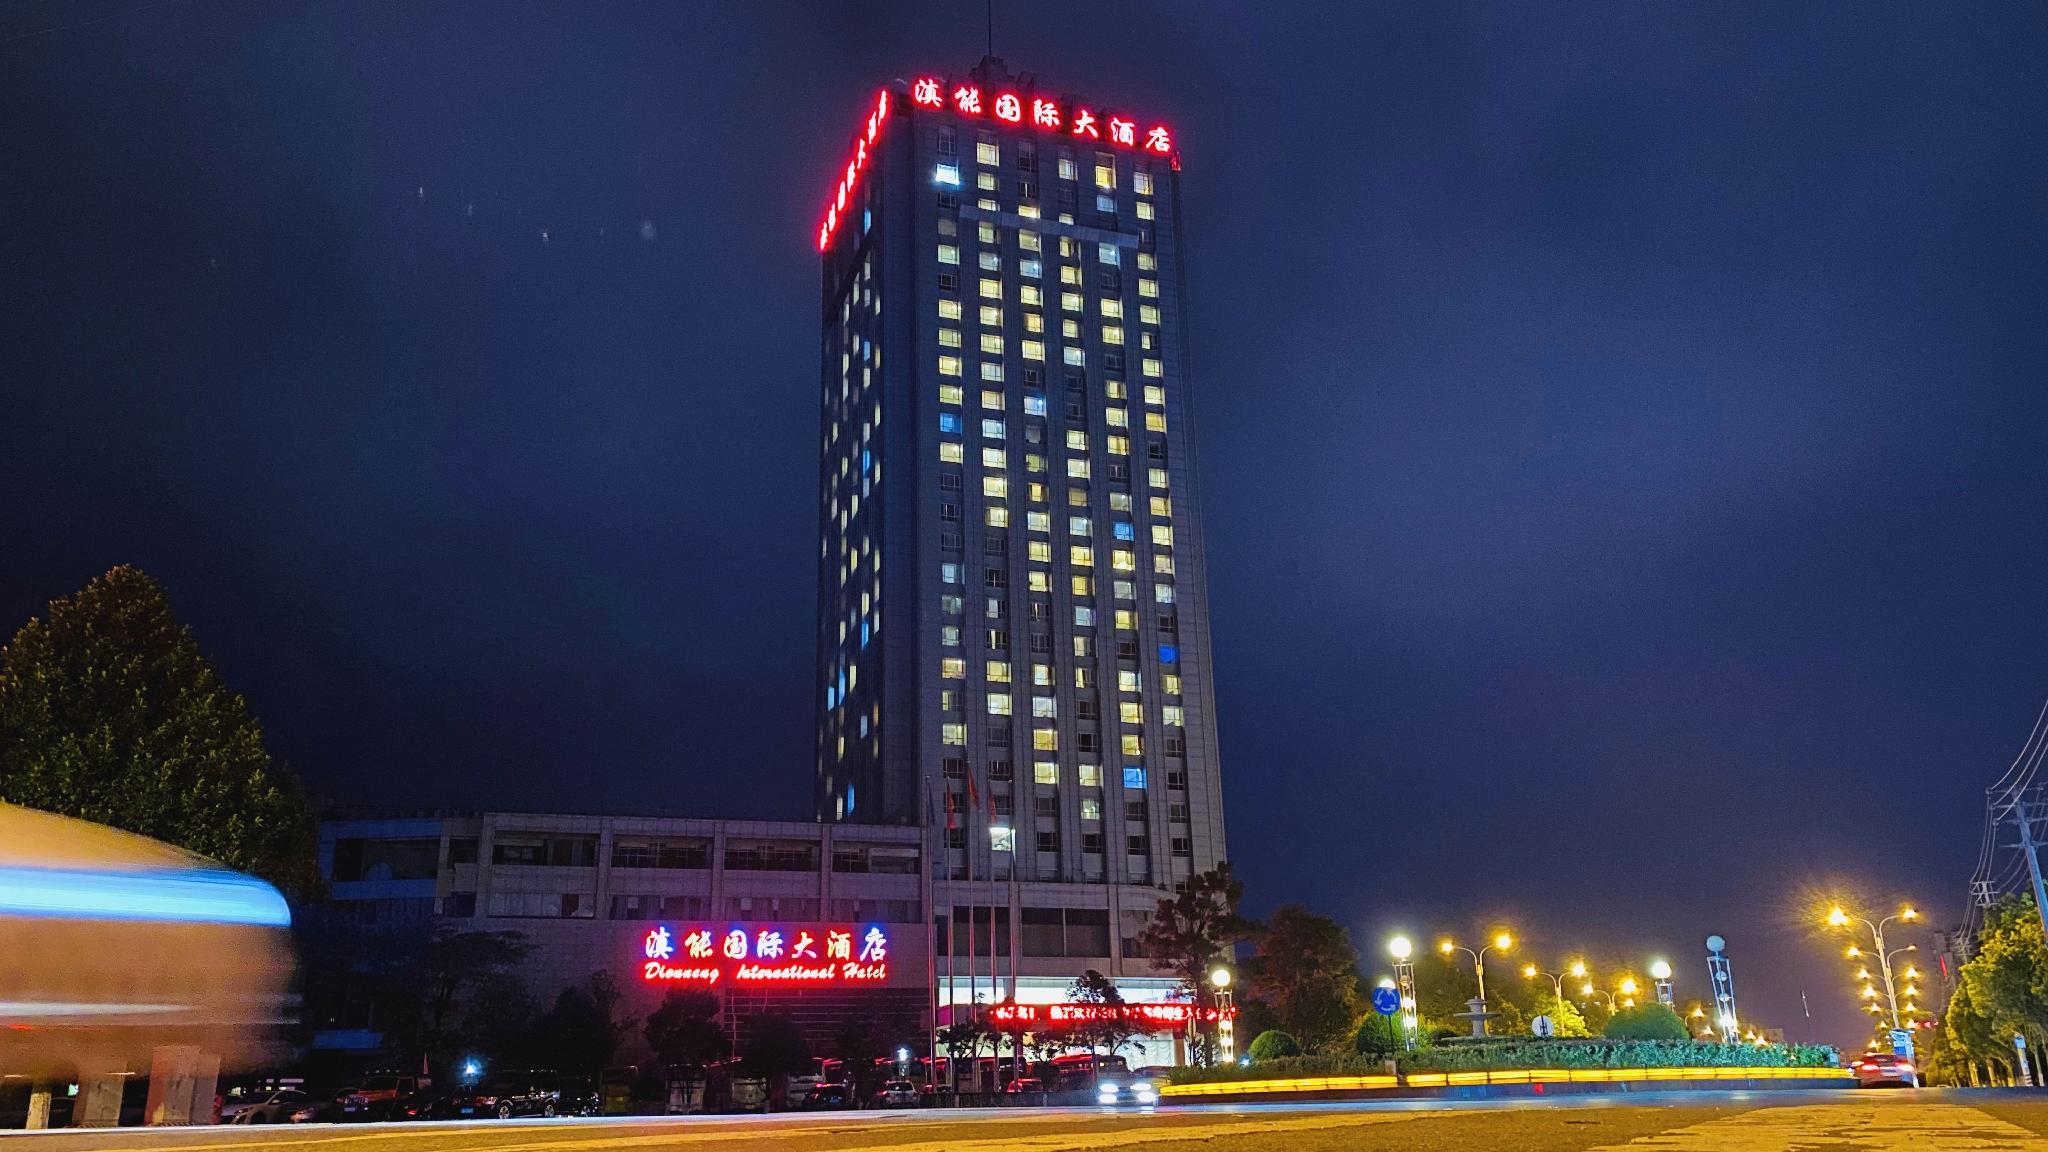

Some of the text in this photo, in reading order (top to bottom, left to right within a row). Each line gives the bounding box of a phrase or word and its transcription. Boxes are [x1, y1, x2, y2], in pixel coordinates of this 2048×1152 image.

[914, 78, 1172, 153] 滇能国际大酒店
[644, 926, 888, 961] 滇能国际大酒店
